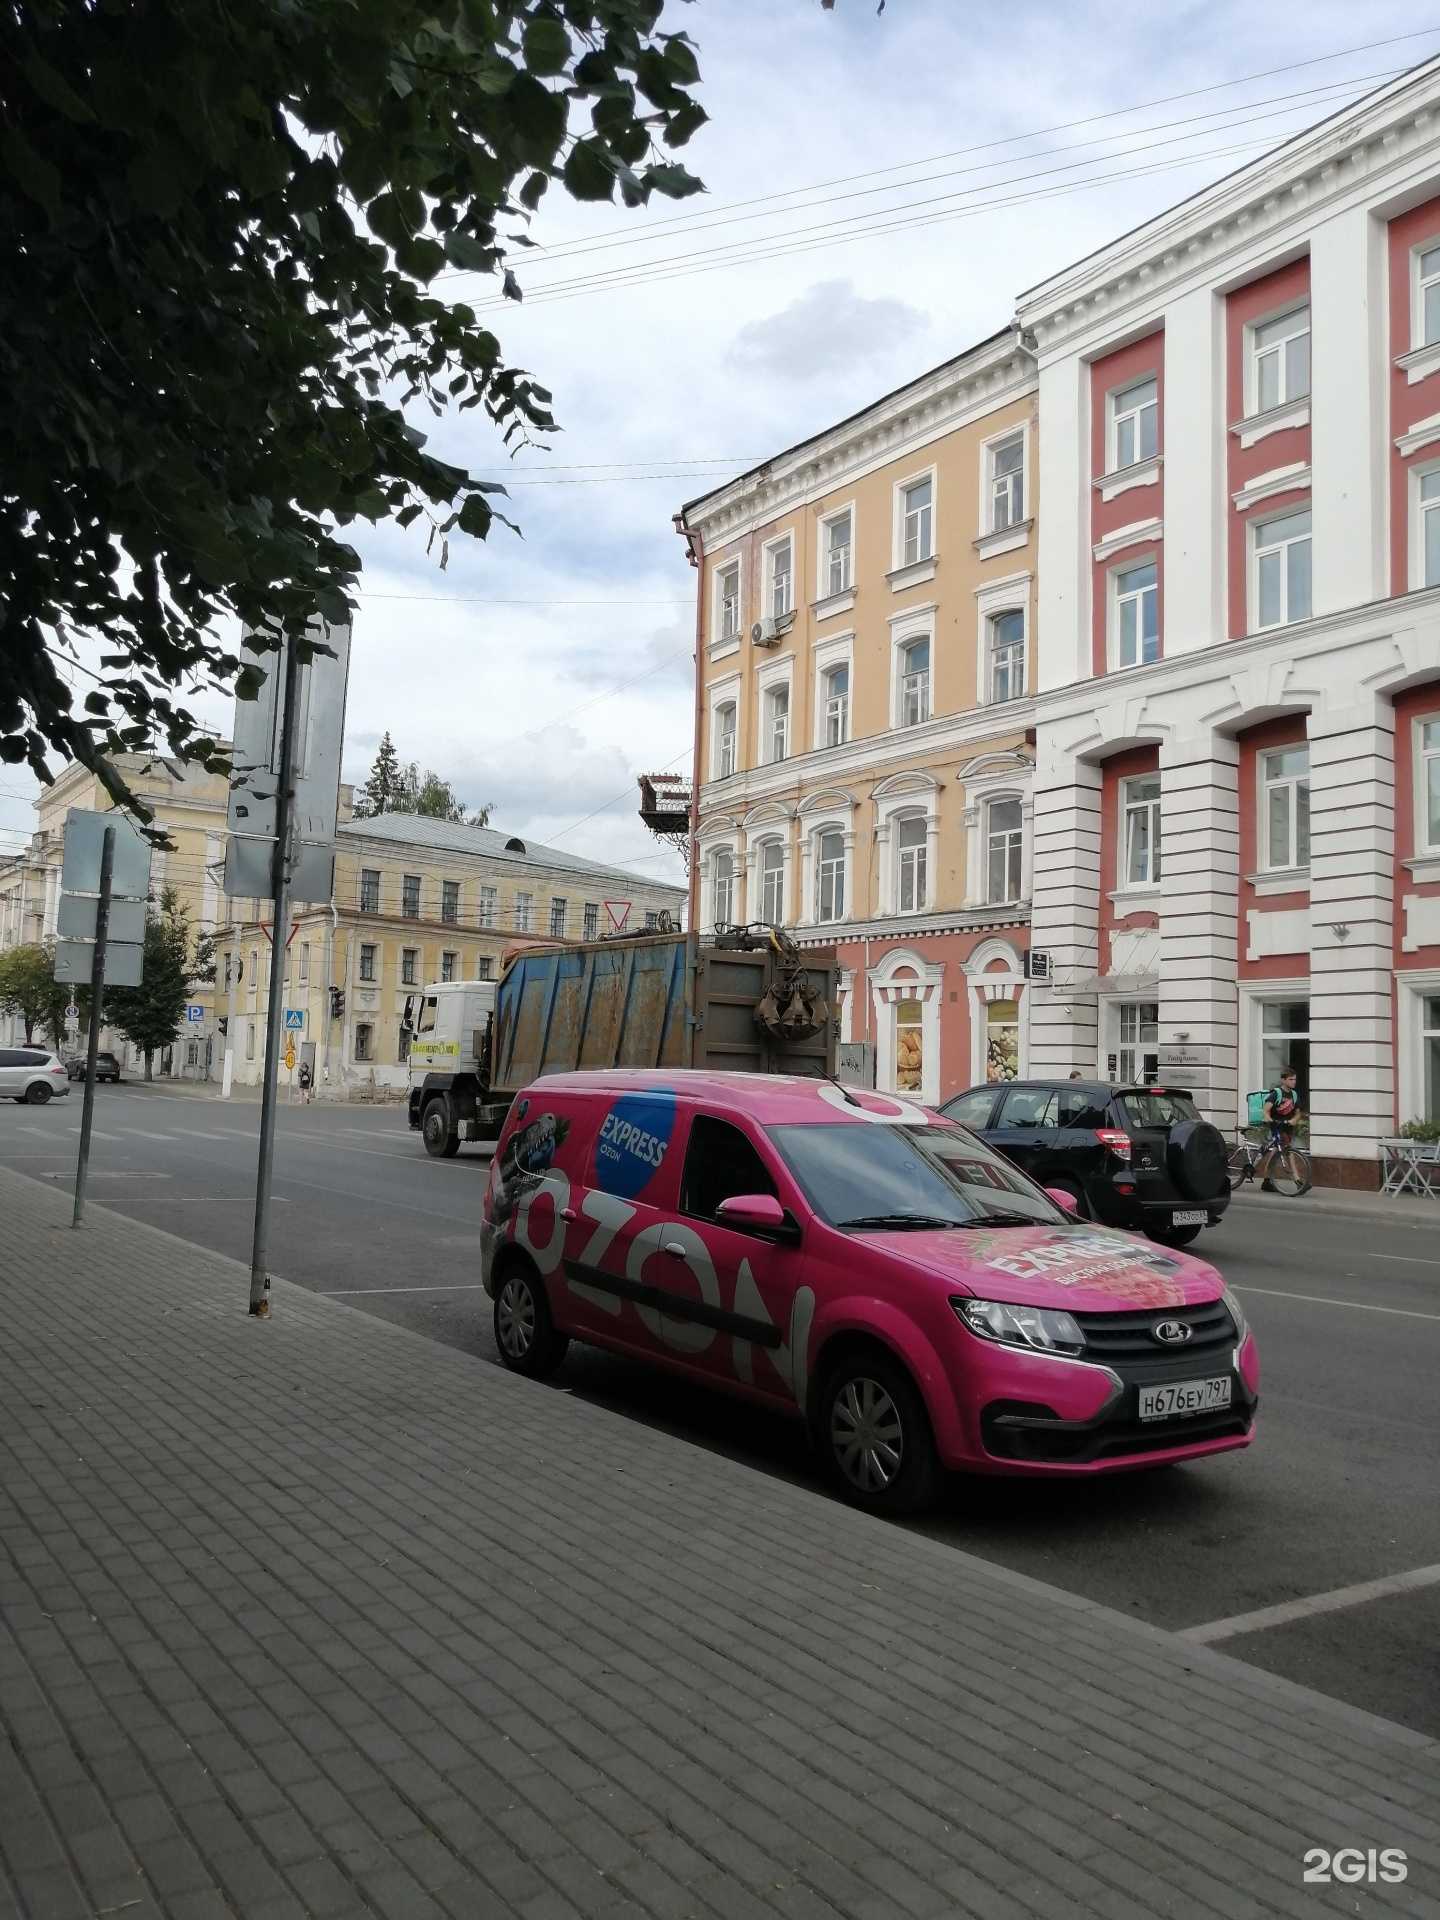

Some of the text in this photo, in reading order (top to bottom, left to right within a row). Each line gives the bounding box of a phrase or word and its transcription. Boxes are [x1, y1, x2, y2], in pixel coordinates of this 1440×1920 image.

[600, 1113, 668, 1167] EXPRESS
[600, 1144, 621, 1161] OZON
[514, 1168, 816, 1417] OZON
